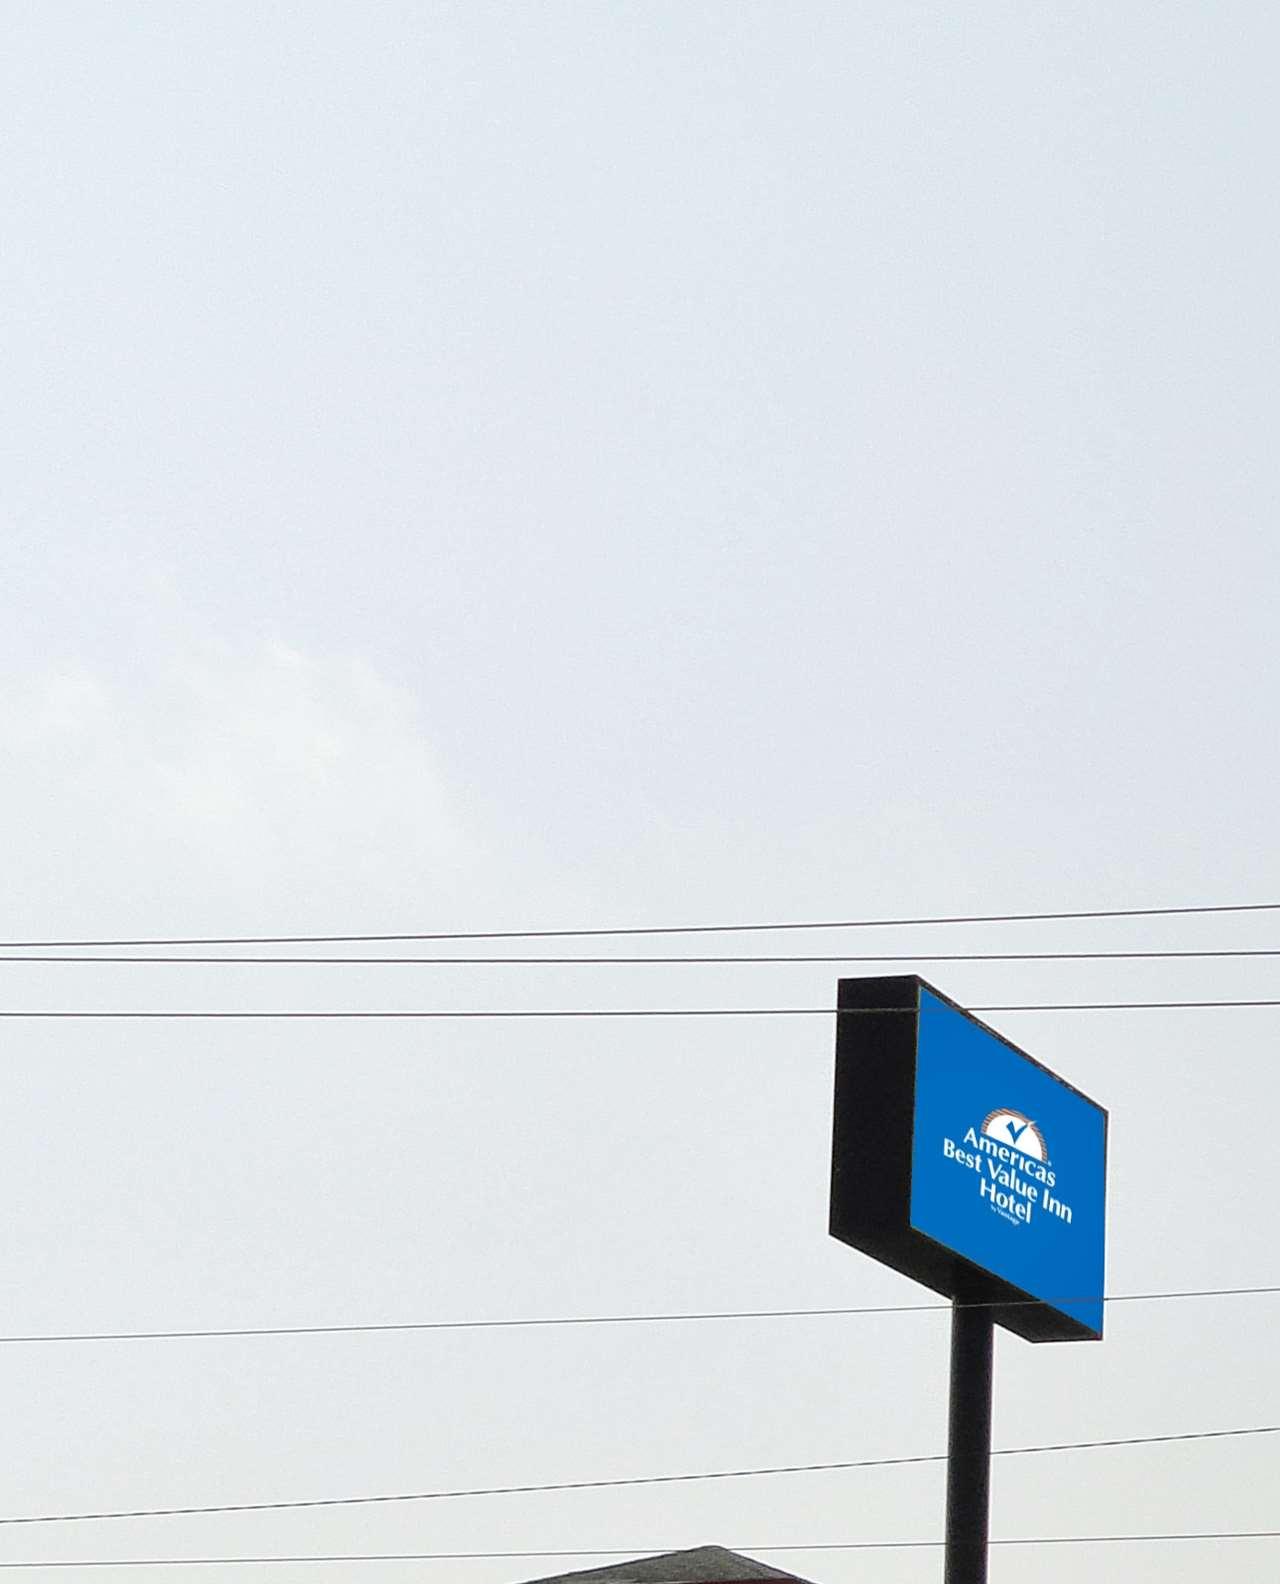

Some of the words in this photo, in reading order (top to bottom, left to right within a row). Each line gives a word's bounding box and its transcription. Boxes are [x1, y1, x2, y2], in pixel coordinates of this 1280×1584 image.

[943, 1138, 982, 1173] Best
[987, 1159, 1038, 1202] Value
[1042, 1188, 1073, 1224] Inn
[963, 1128, 1056, 1187] Americas
[980, 1178, 1032, 1224] Hotel
